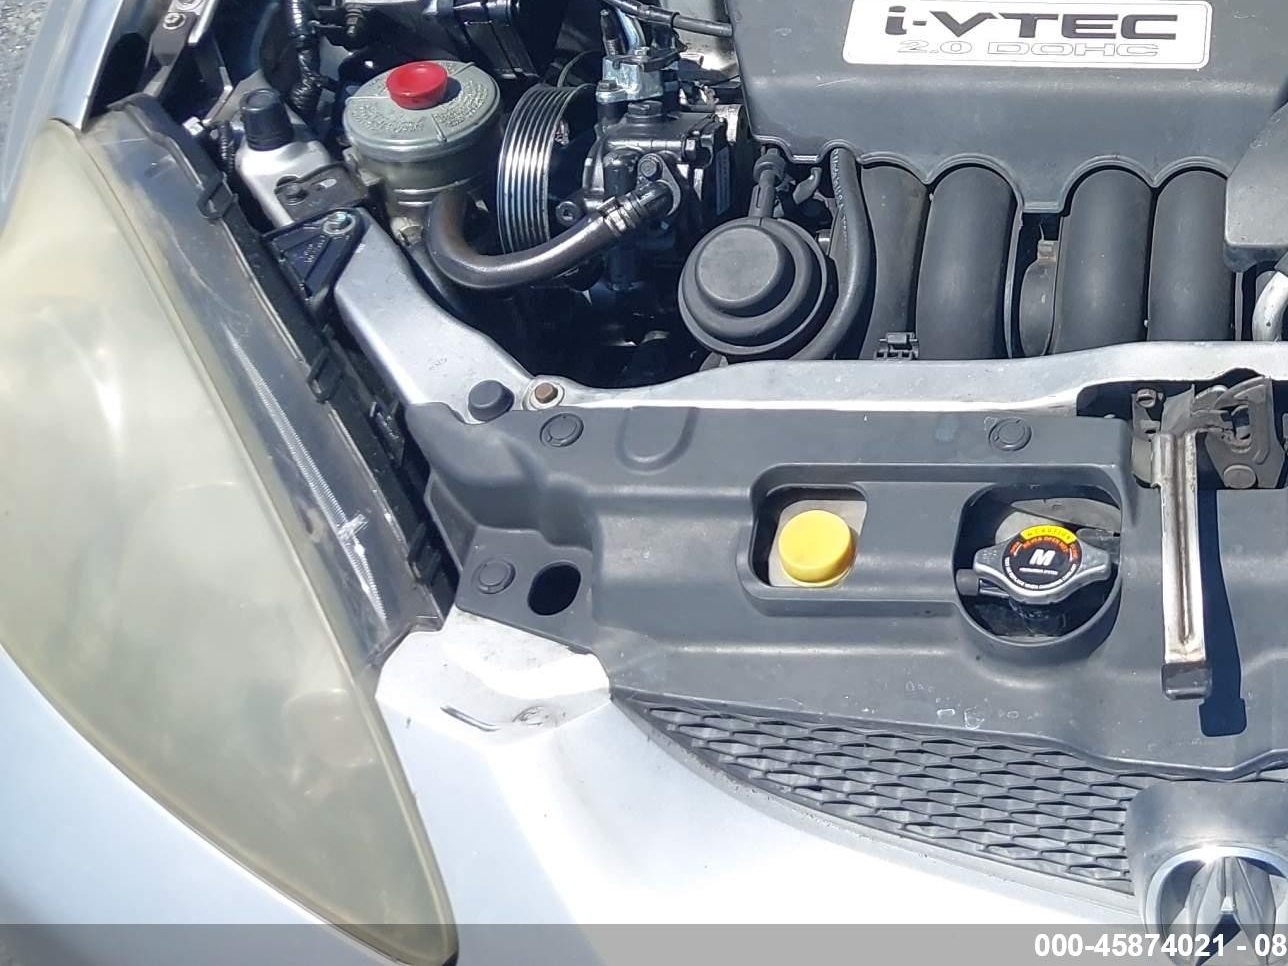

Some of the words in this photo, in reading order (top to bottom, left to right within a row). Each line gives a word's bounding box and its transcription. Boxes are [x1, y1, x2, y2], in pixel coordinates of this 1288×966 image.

[885, 5, 1178, 40] i-VTEC
[897, 39, 973, 54] 2.0
[987, 41, 1159, 57] DOHC
[1034, 528, 1071, 540] CAUTION
[1029, 548, 1056, 566] M
